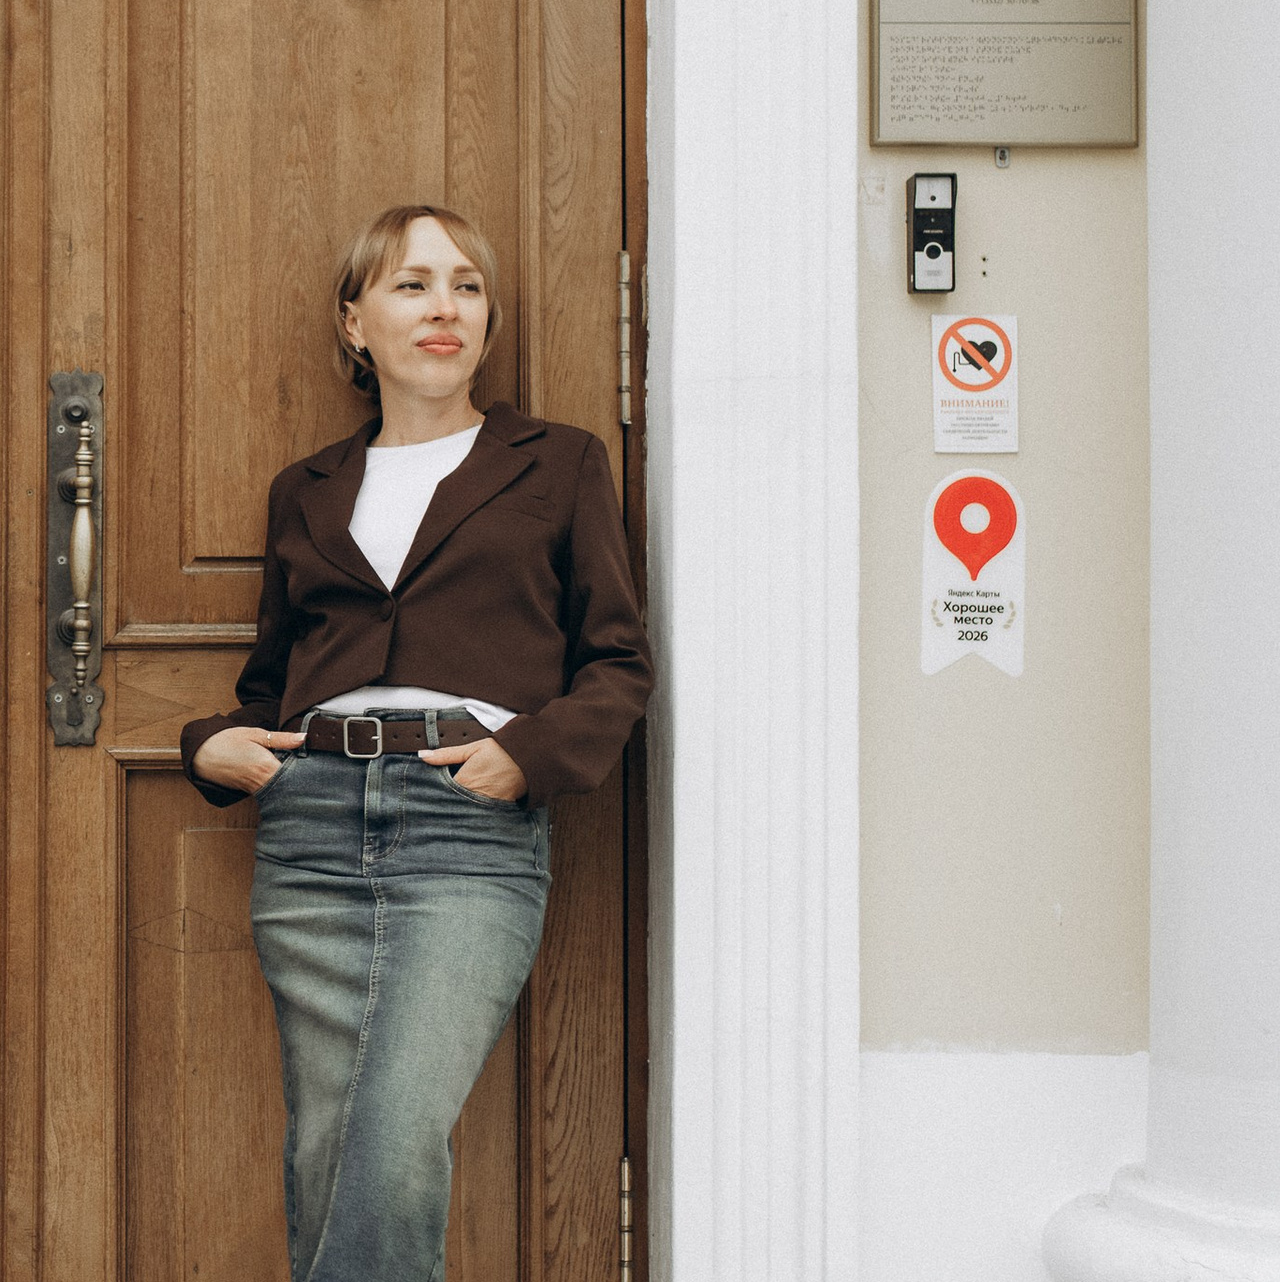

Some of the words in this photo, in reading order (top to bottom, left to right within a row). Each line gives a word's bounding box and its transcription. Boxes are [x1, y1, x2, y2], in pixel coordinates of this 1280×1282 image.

[940, 399, 1010, 408] ВНИМАНИЕ!
[948, 589, 974, 597] Яндекс
[976, 590, 1000, 598] Карты
[943, 601, 1005, 614] Хорошее
[953, 616, 994, 625] место
[957, 630, 989, 641] 2026
